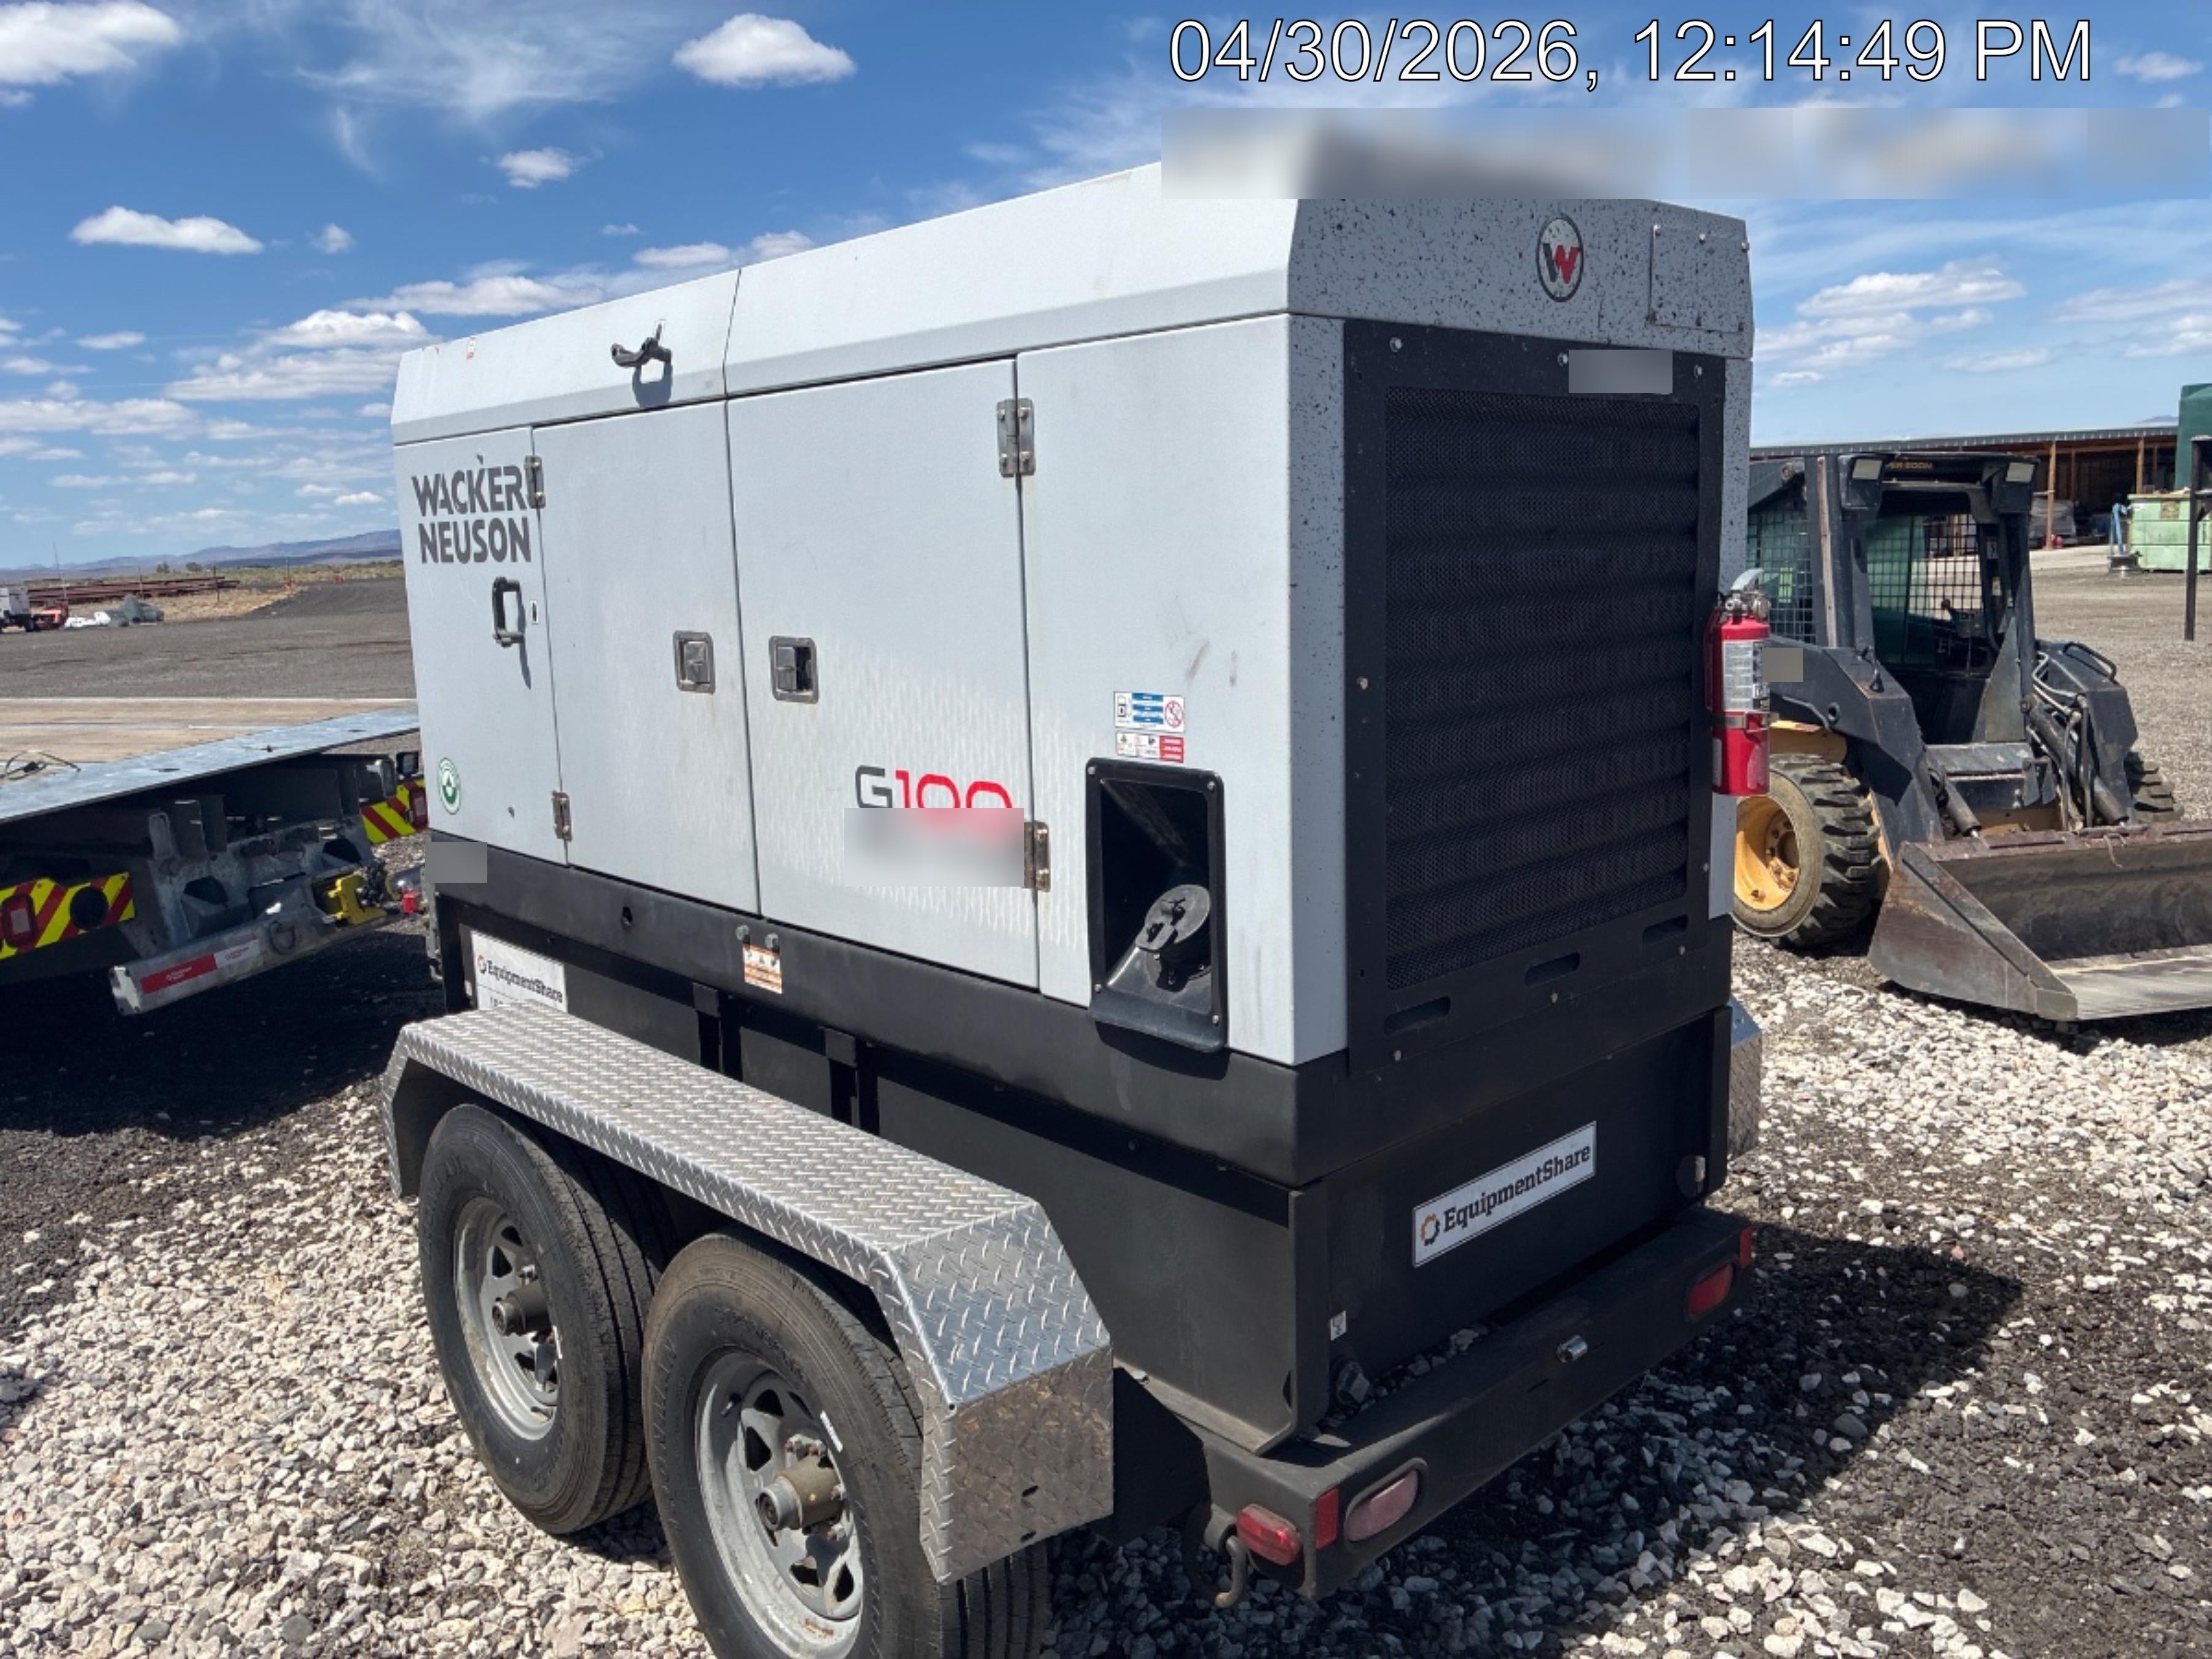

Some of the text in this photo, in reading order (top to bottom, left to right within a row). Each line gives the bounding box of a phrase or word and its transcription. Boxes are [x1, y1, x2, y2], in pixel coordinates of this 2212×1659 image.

[411, 465, 526, 517] WACKER
[418, 516, 531, 565] NEUSON
[486, 959, 563, 1004] EquipmentShare
[1443, 1145, 1591, 1233] EquipmentShare
